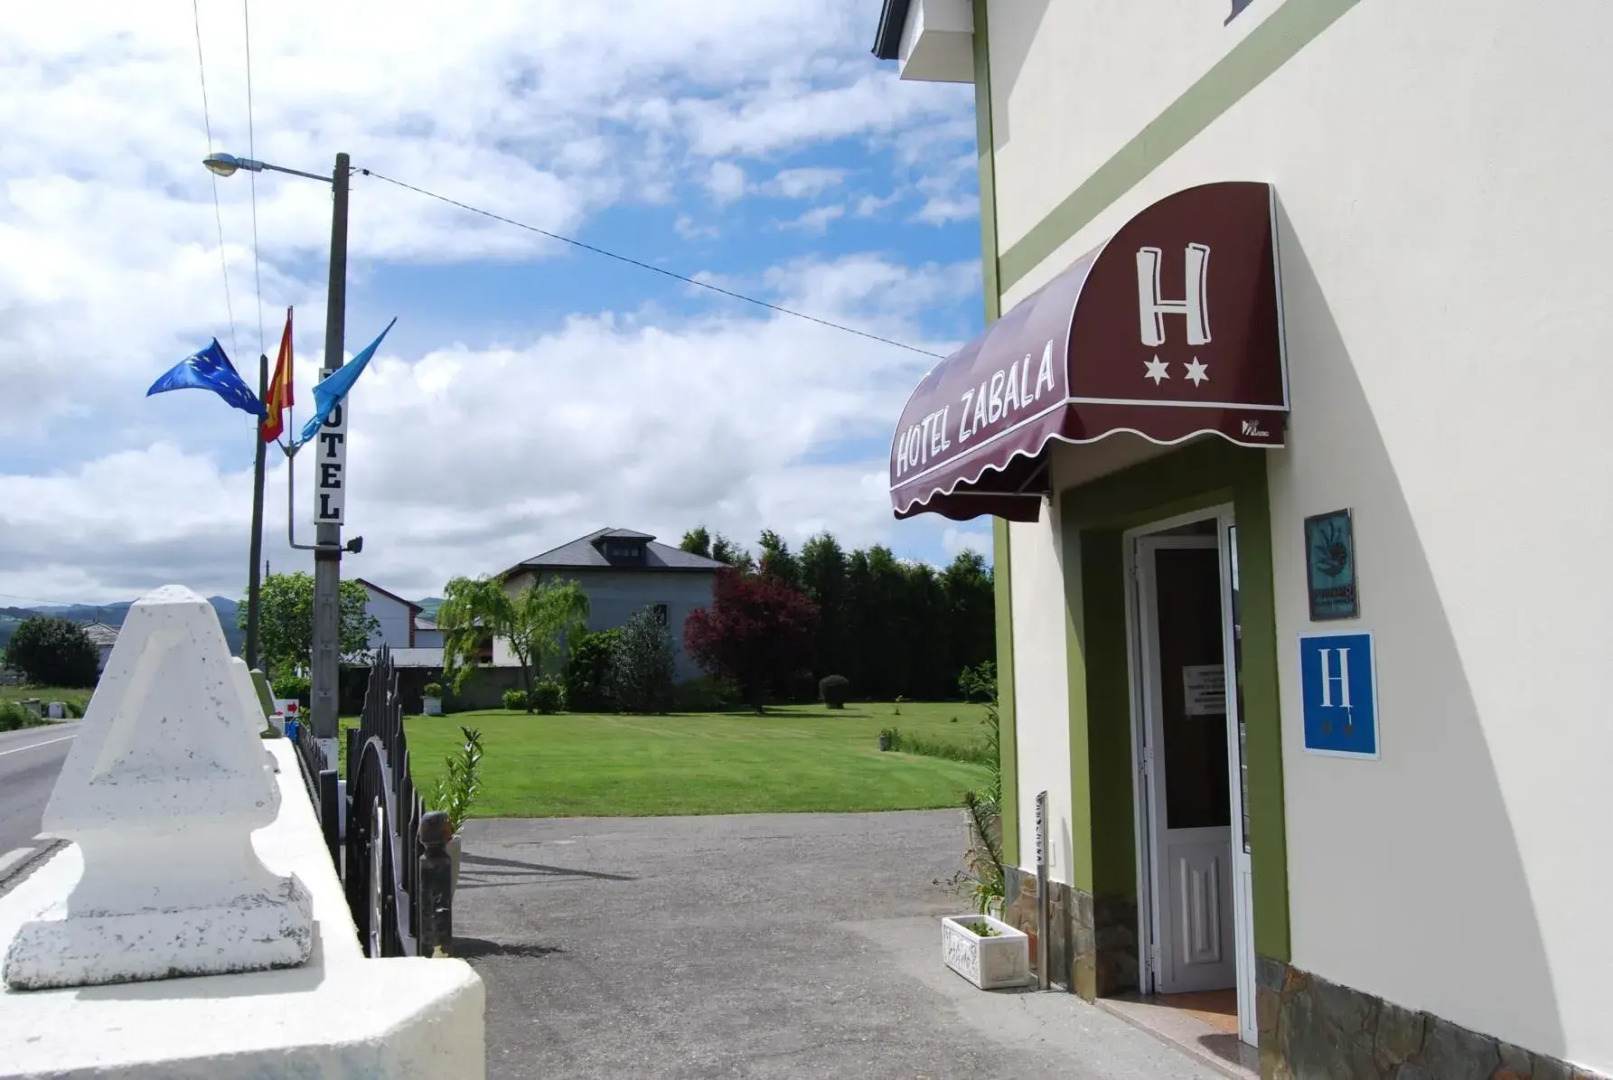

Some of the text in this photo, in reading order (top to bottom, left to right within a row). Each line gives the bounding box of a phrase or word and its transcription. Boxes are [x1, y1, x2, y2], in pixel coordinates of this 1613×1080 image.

[1136, 242, 1212, 347] H
[319, 372, 344, 520] OTEL
[896, 339, 1055, 477] HOTEL ZABALA
[1317, 647, 1354, 708] H
